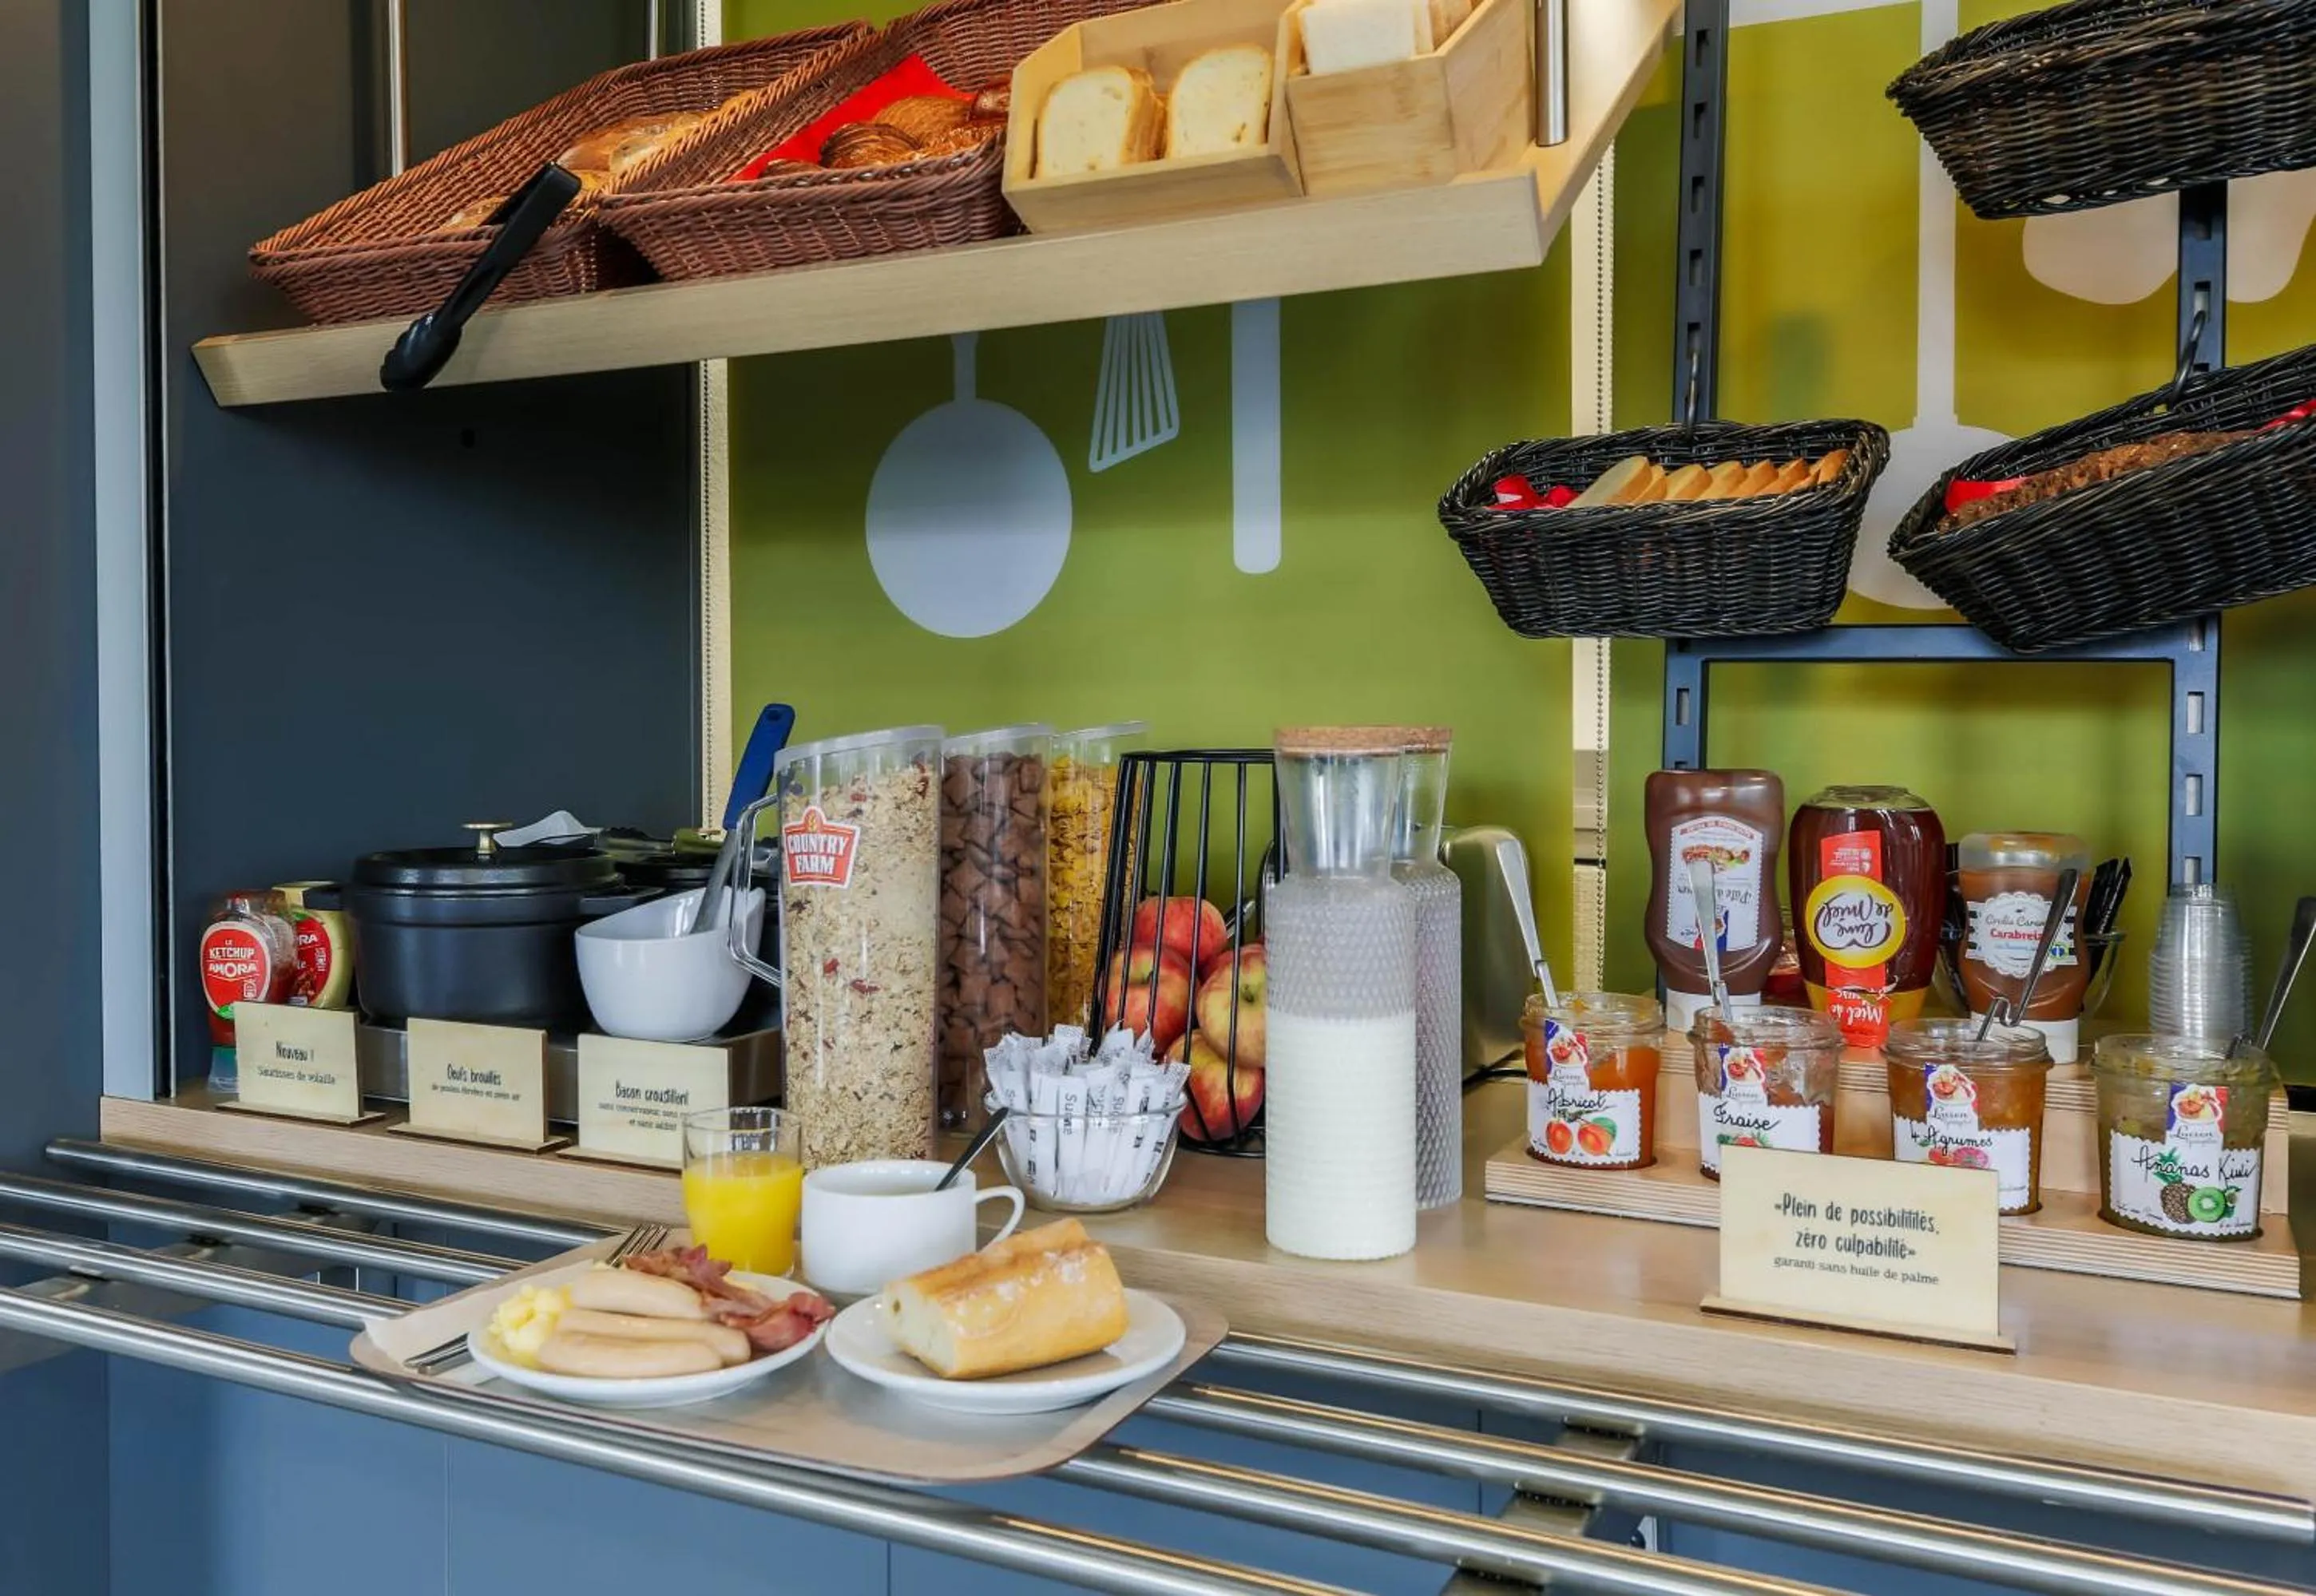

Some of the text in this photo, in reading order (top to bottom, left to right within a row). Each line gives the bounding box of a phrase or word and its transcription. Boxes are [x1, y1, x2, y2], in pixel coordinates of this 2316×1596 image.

[787, 834, 850, 856] COUNTRY
[795, 854, 836, 875] FARM
[1875, 901, 1894, 918] de
[209, 947, 255, 958] KETCHUP
[209, 962, 257, 977] AMORA
[1846, 1004, 1884, 1026] Miel
[1546, 1087, 1607, 1113] Abricot
[1713, 1102, 1781, 1131] Fraise
[2132, 1146, 2210, 1182] Ananas
[1825, 1201, 1842, 1222] de
[1795, 1227, 1826, 1249] zéro
[1774, 1256, 1940, 1285] garanti sans huile de palme
